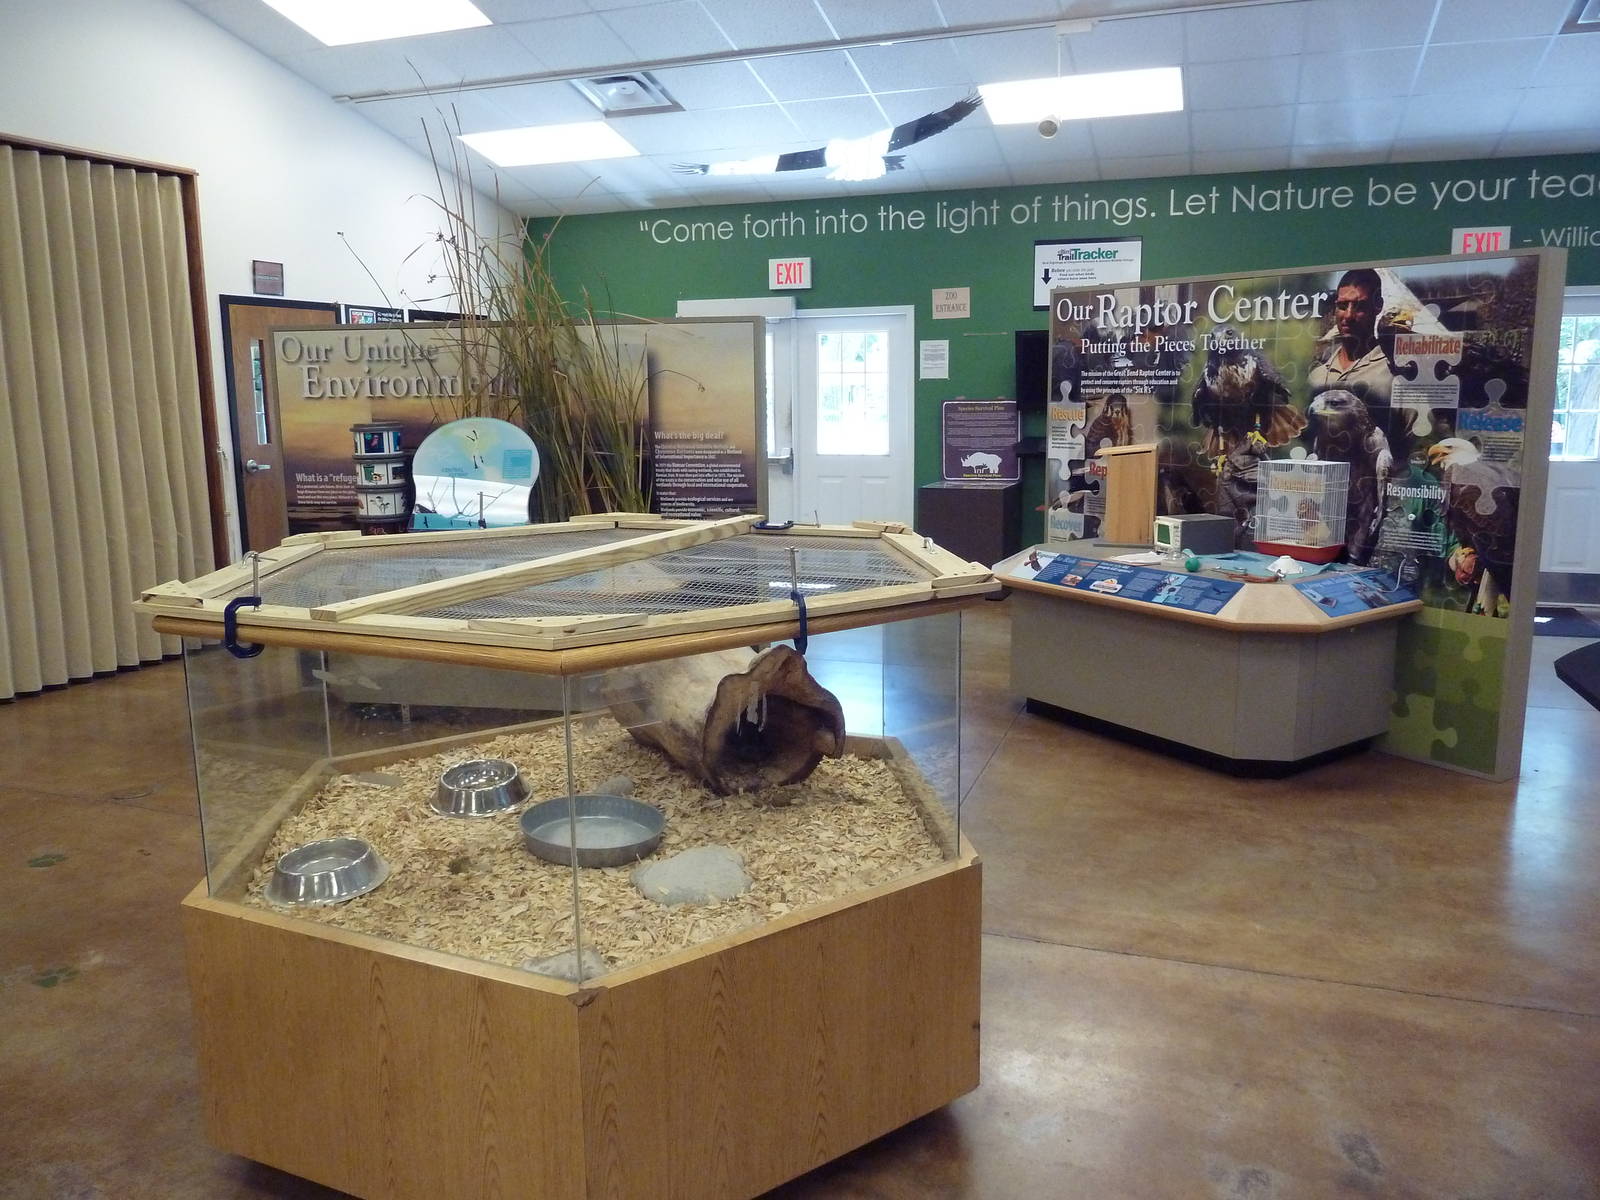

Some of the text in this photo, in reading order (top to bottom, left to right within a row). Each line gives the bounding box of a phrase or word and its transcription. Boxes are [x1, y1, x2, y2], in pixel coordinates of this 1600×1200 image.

[639, 169, 1600, 245] "Come forth into the light of things. Let Nature be your tea
[1463, 231, 1502, 254] EXIT
[776, 262, 804, 285] EXIT
[945, 291, 958, 300] ZOO
[935, 302, 967, 314] ENTRANCE
[1056, 284, 1328, 335] Our Raptor Center
[281, 335, 441, 367] Our Unique
[1080, 332, 1266, 356] Putting the Pieces Together
[1395, 335, 1461, 355] Rehabilitate
[300, 365, 521, 400] Environmen
[1052, 407, 1084, 422] Rescue
[692, 432, 704, 440] big
[296, 473, 316, 482] What
[316, 473, 322, 482] is
[324, 474, 328, 482] a
[1089, 461, 1108, 480] Rep
[1386, 482, 1447, 503] Responsibility
